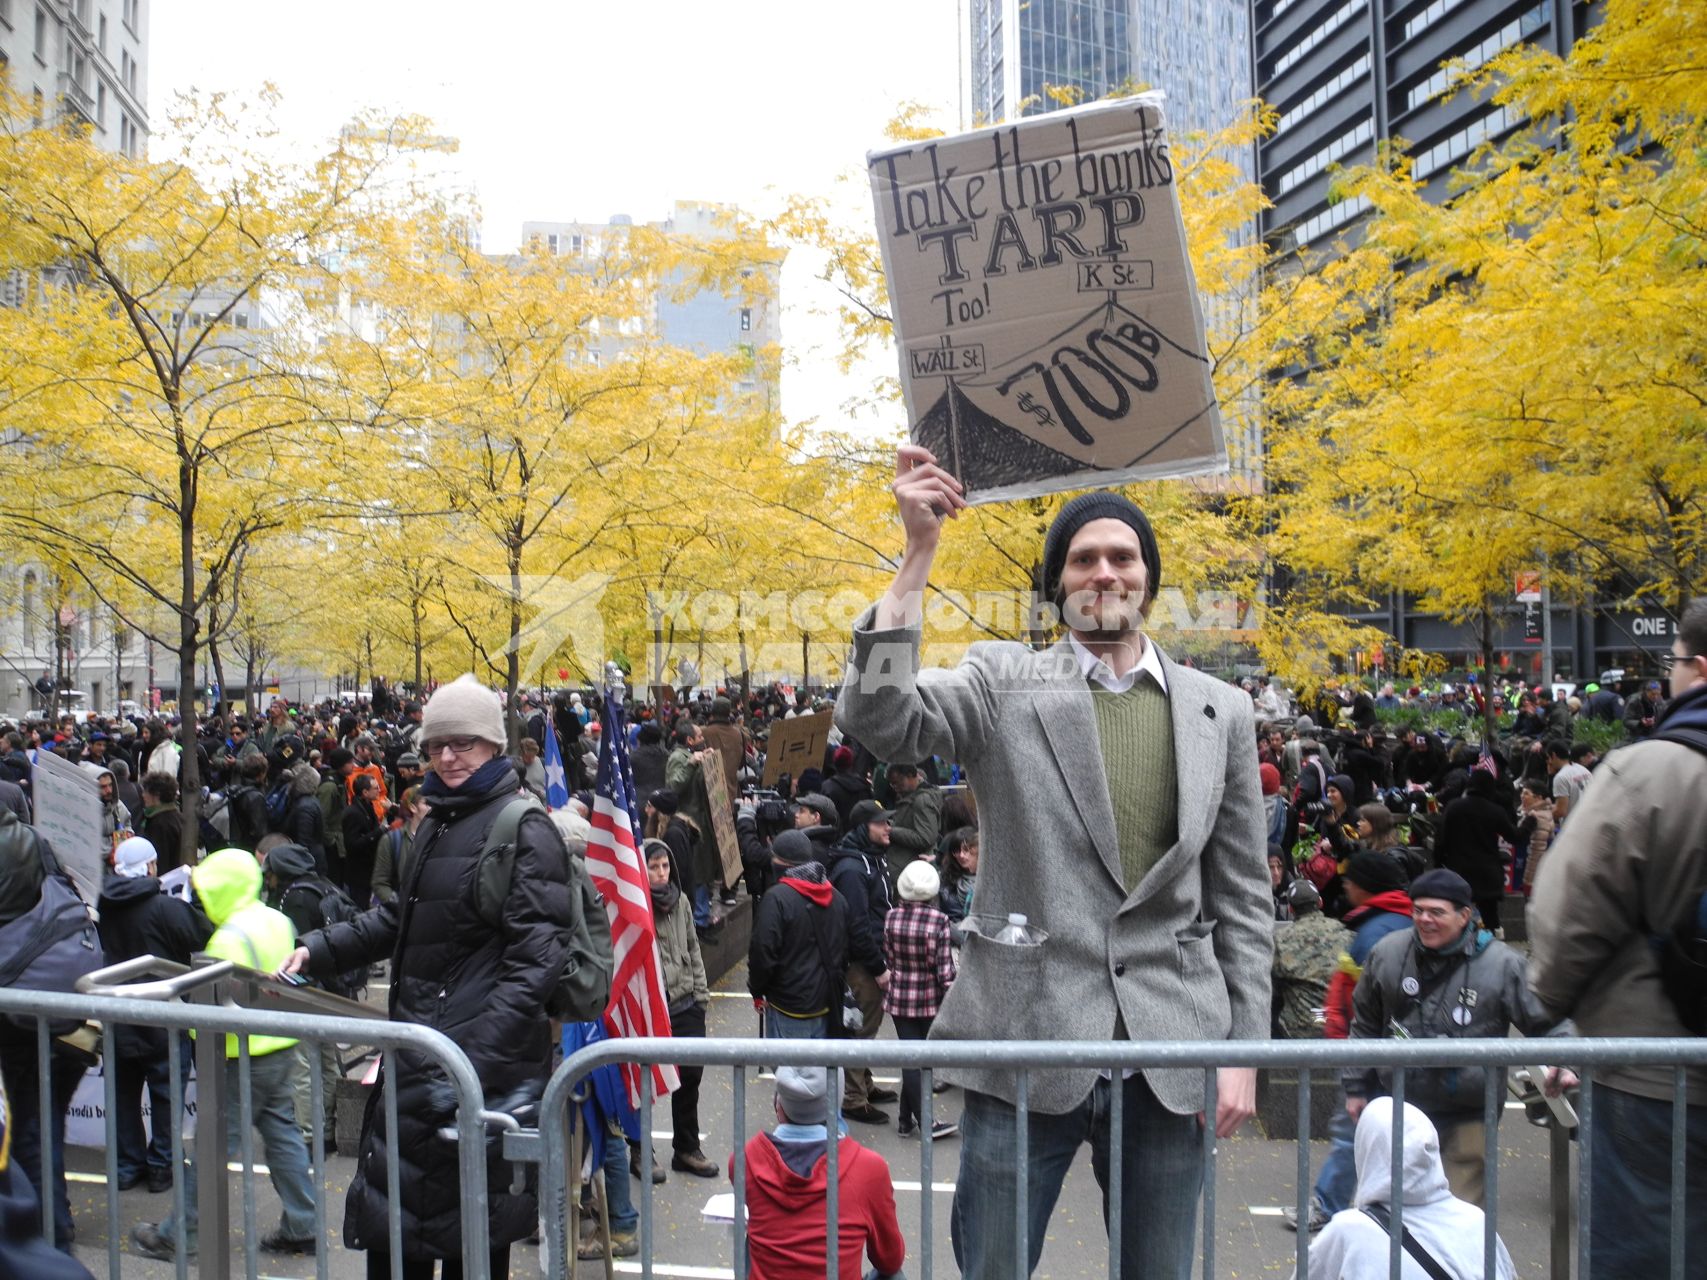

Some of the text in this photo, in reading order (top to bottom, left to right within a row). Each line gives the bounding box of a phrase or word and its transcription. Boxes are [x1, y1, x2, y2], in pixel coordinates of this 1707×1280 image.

[868, 106, 1173, 237] Take the banks
[917, 191, 1146, 286] TARP
[1084, 263, 1138, 288] K St.
[912, 350, 958, 375] WALL
[996, 322, 1161, 446] $700B
[1632, 617, 1666, 635] ONE
